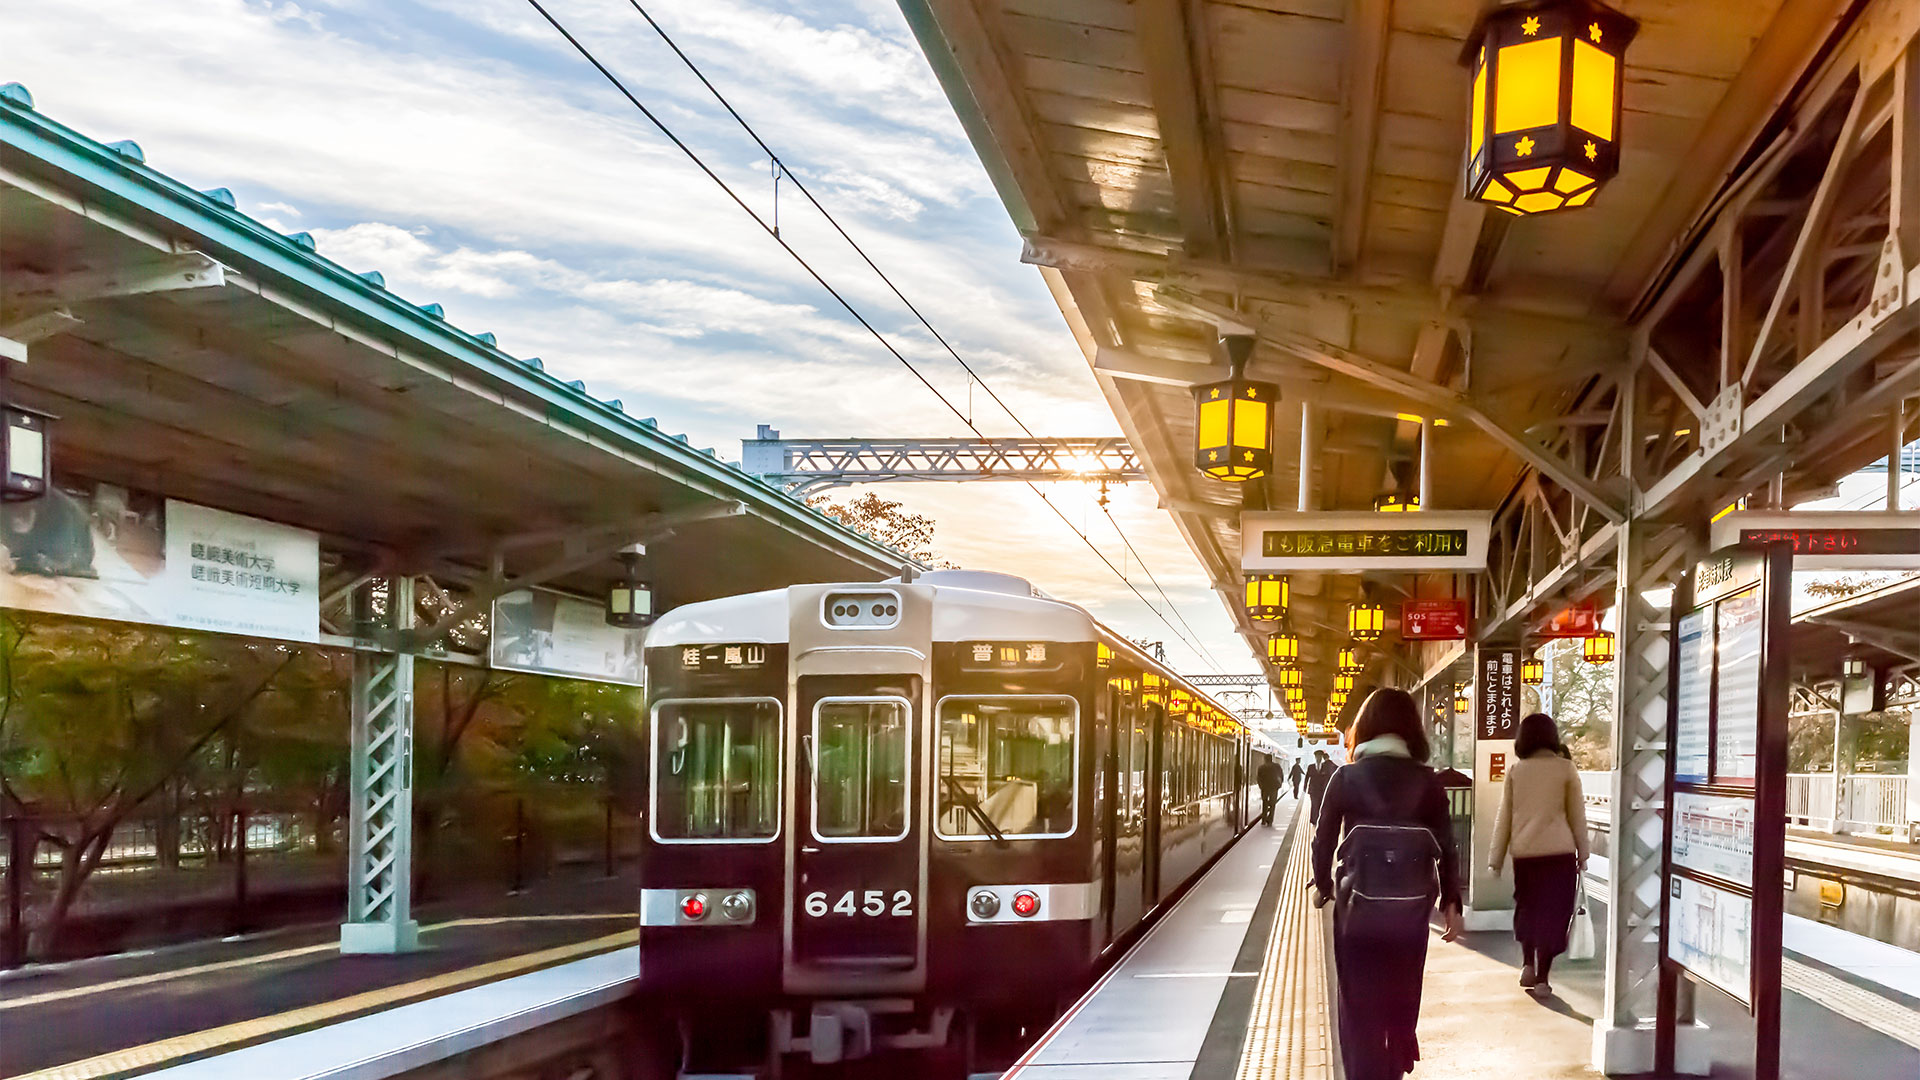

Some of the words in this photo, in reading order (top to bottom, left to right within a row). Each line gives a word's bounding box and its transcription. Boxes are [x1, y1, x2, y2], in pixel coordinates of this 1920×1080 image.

[972, 644, 1047, 663] 普通
[1486, 660, 1498, 737] 前にとまります
[1501, 653, 1513, 730] 電車はこれより
[805, 890, 913, 917] 6452
